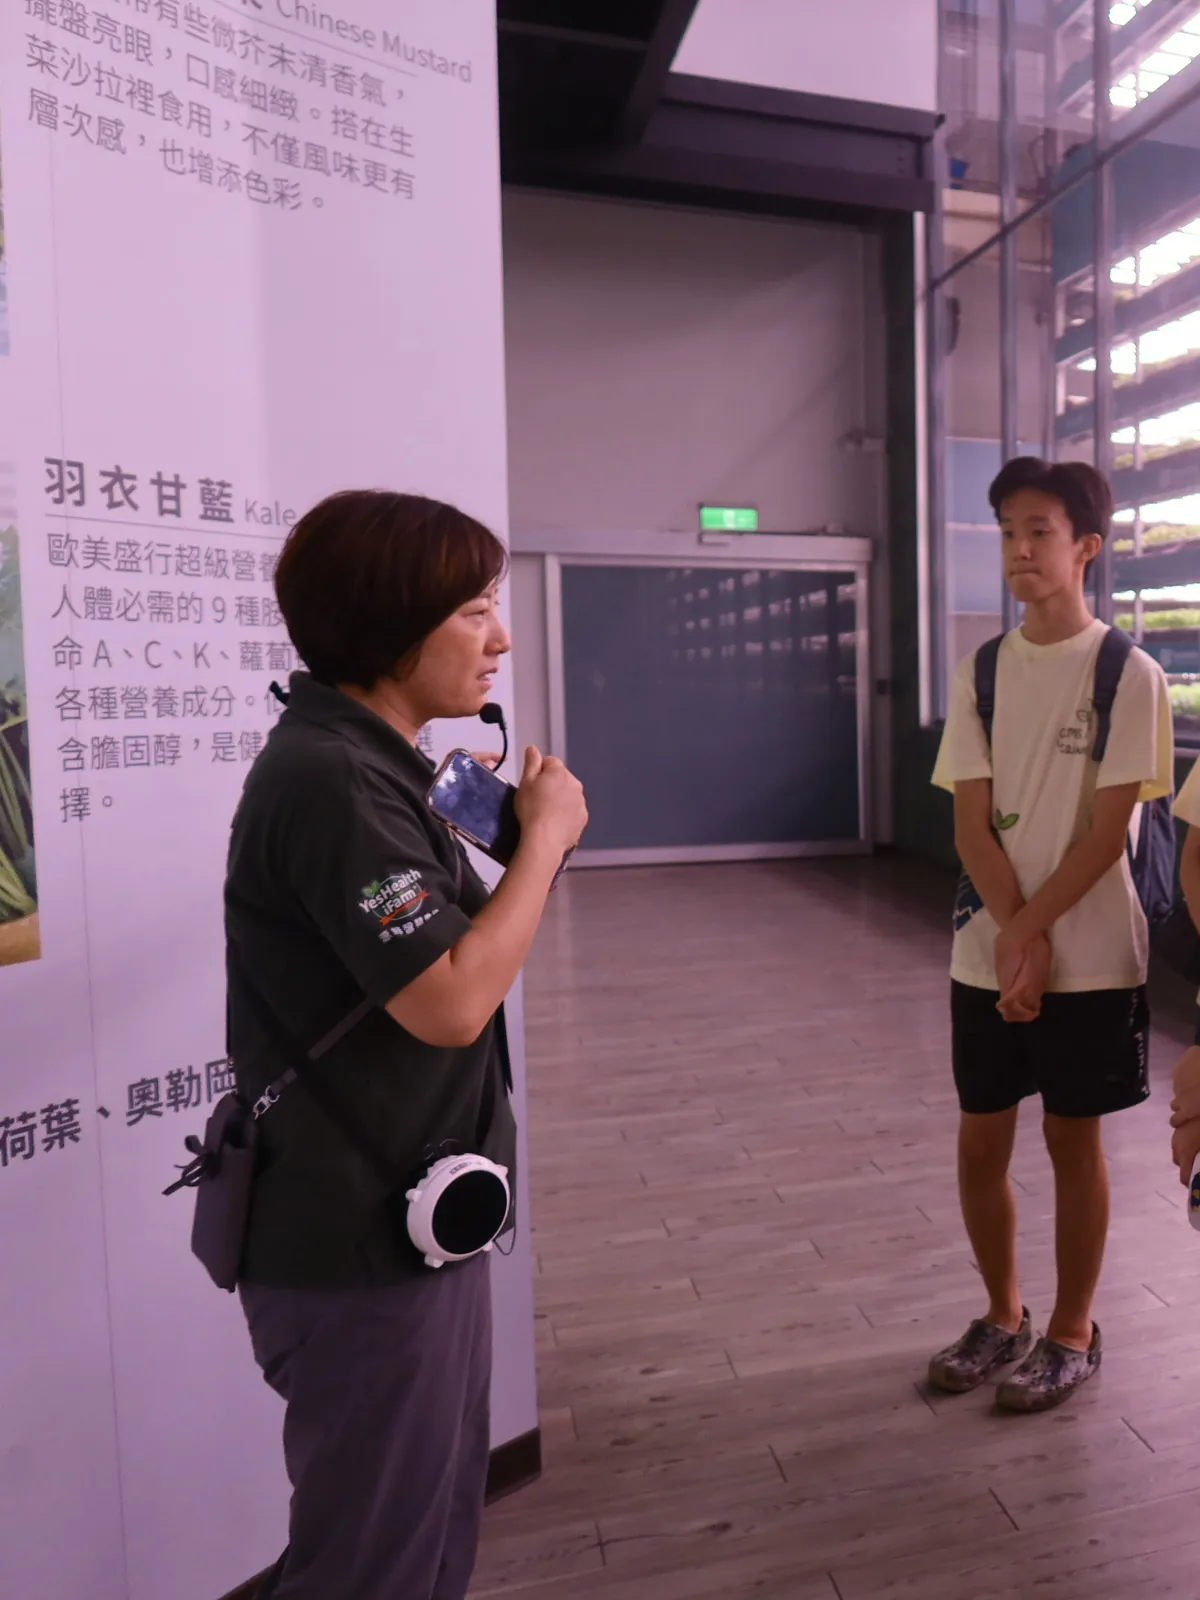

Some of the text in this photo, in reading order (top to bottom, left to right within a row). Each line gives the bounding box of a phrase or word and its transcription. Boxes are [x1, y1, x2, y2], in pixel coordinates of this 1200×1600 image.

[276, 0, 473, 83] Chinese Mustard
[27, 87, 325, 211] 層次感，也增添色彩。
[44, 457, 296, 527] 羽衣甘藍 Kale
[52, 635, 307, 672] 命A、C、K、蘿蔔
[60, 787, 113, 823] 擇。
[359, 867, 422, 913] YesHealth
[381, 888, 417, 915] iFarm
